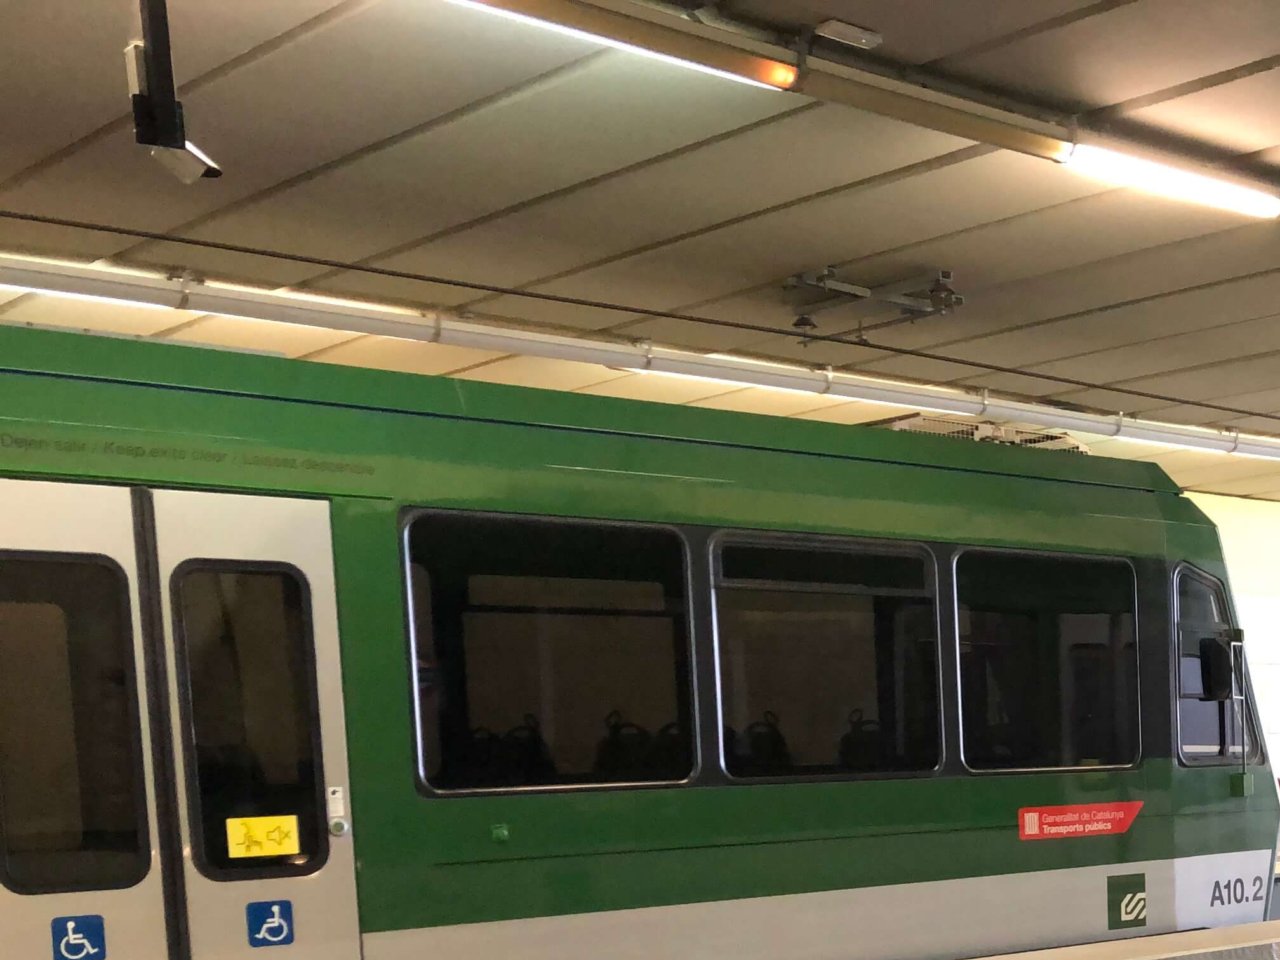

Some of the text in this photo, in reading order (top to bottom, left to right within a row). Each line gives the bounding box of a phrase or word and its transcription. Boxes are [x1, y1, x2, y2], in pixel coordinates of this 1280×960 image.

[104, 440, 145, 458] Keep
[149, 445, 186, 460] exits
[1042, 810, 1124, 823] Generalitat de Catalunya
[1042, 821, 1112, 834] Transports públics
[1210, 875, 1264, 907] A10.2
